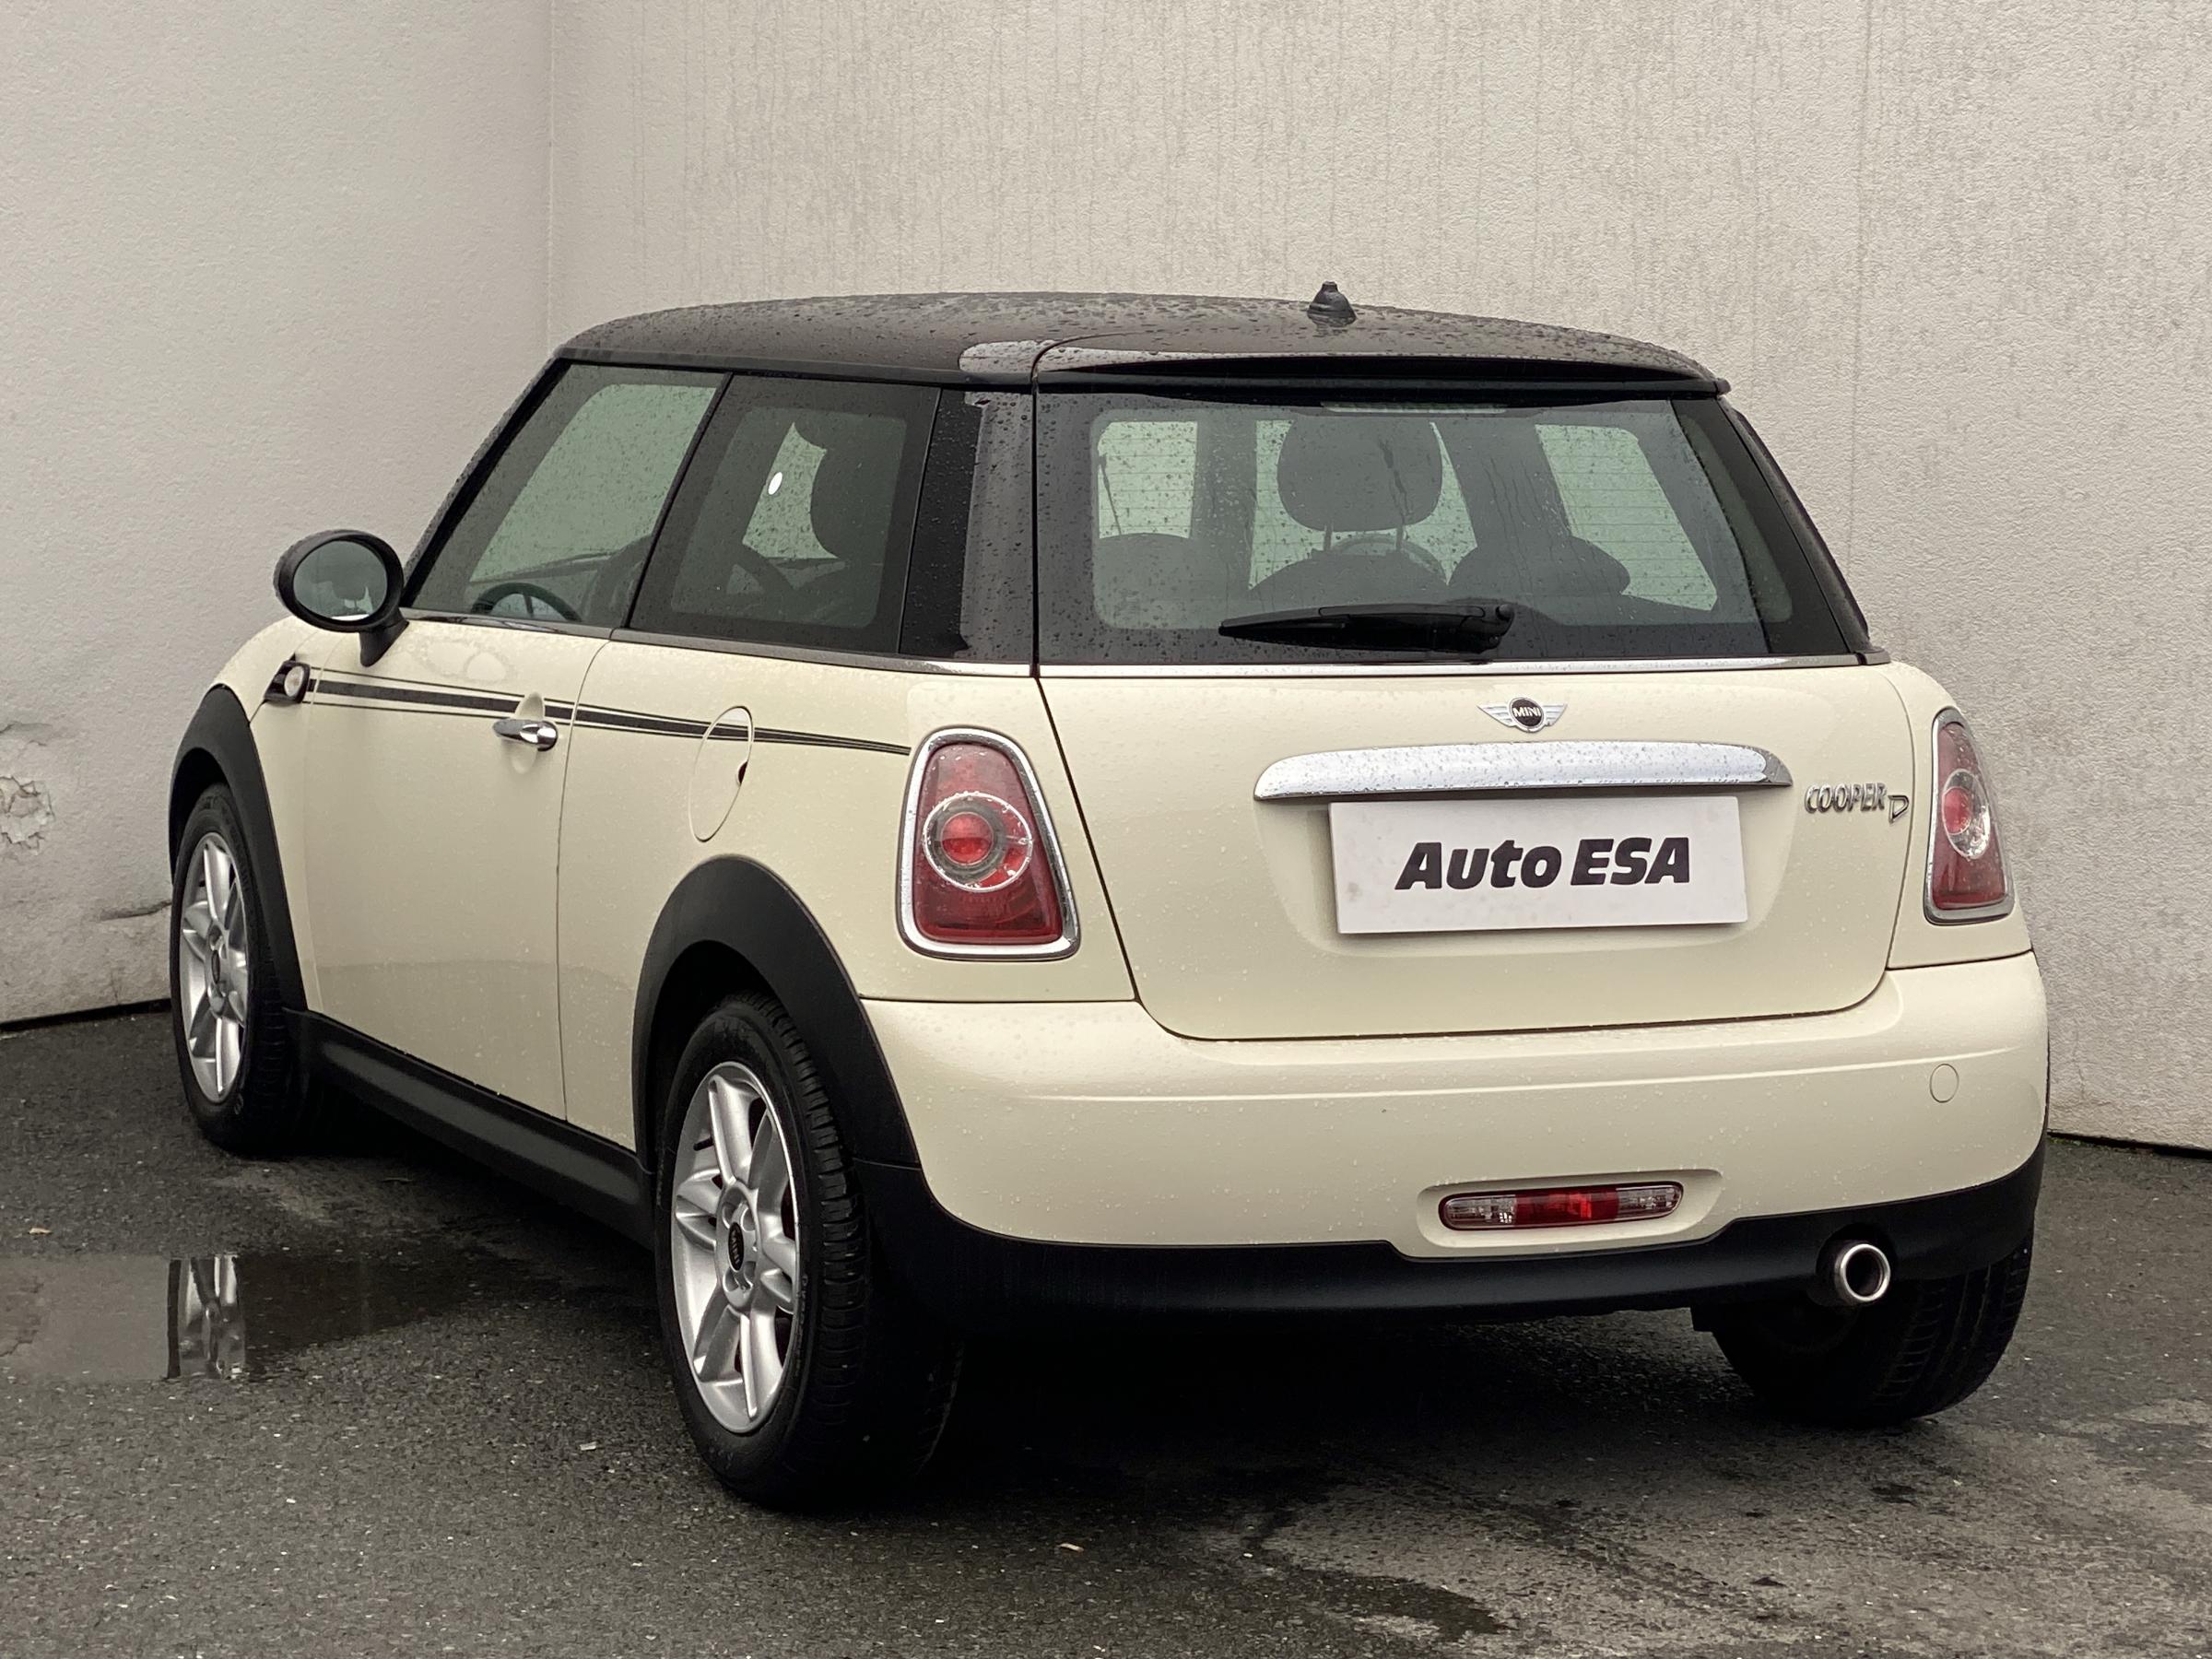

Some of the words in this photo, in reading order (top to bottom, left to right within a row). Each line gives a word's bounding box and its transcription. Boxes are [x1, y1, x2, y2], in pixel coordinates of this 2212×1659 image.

[1512, 706, 1542, 718] MINI
[1804, 782, 1887, 813] COOPER
[1888, 794, 1910, 824] D
[1394, 840, 1561, 890] Auto
[1570, 837, 1690, 887] ESA
